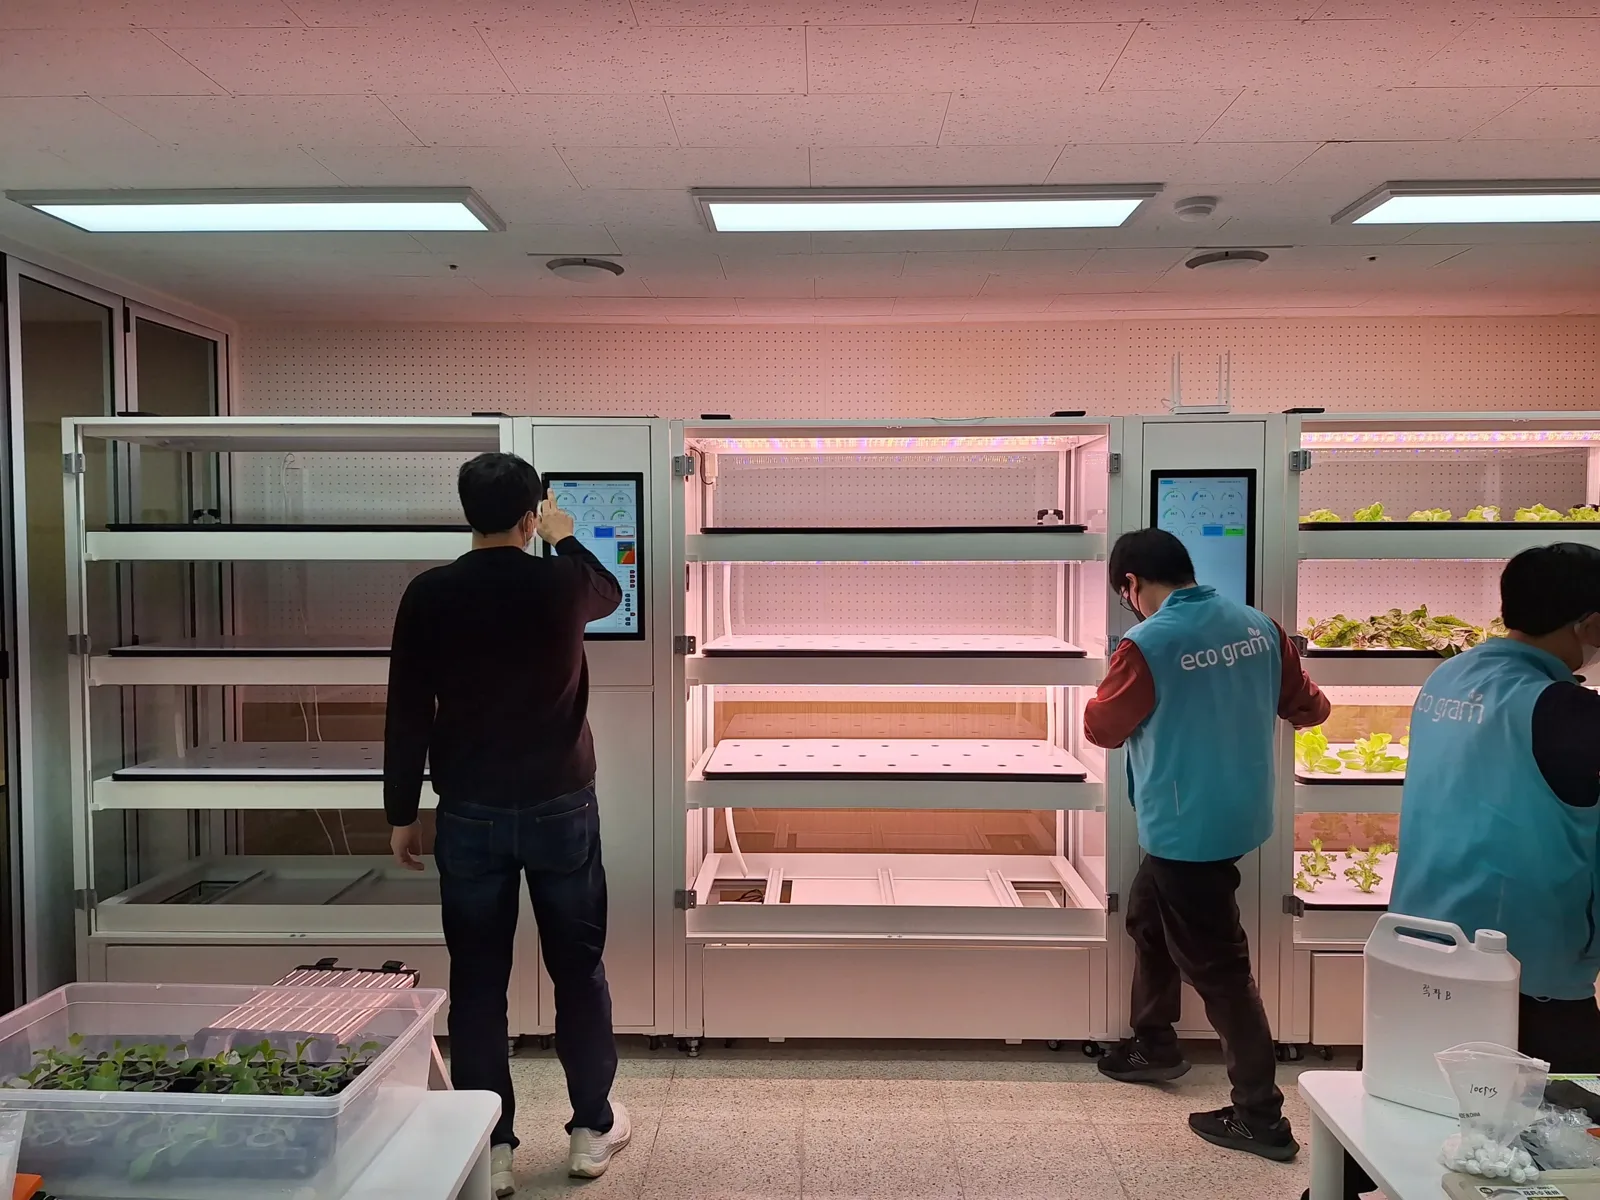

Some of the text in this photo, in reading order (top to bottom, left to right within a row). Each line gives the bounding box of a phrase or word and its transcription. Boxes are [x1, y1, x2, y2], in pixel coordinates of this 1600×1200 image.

[1181, 635, 1270, 671] eco gram
[1415, 693, 1485, 724] co gram
